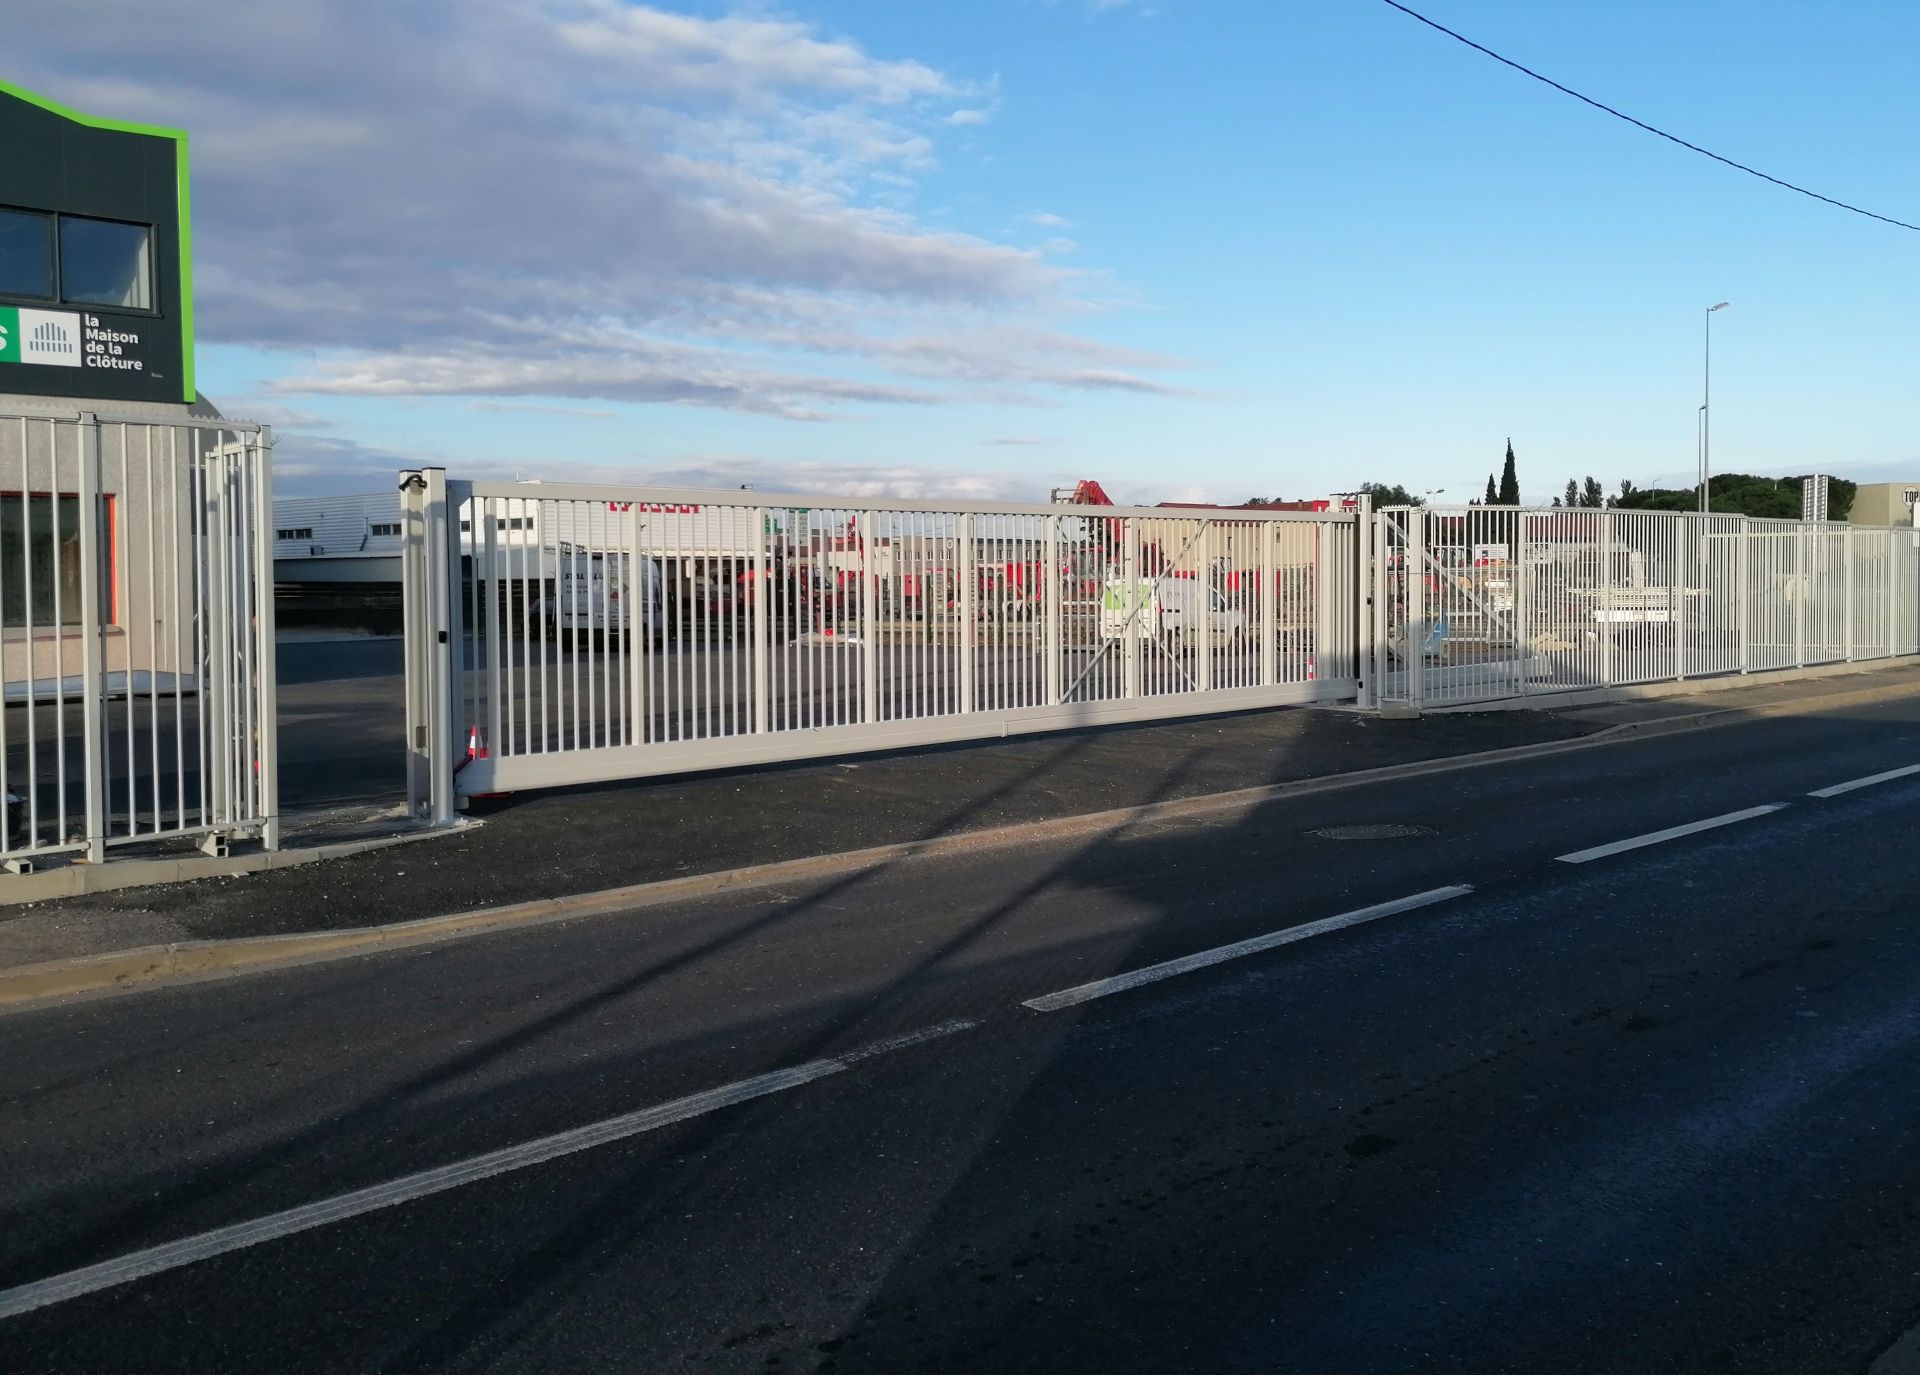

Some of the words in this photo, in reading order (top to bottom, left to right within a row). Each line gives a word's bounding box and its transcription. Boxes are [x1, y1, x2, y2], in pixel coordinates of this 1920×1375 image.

[85, 313, 99, 327] la
[85, 328, 139, 344] Maison
[85, 341, 105, 354] de
[109, 343, 123, 356] la
[86, 355, 143, 371] Clôture
[1904, 491, 1919, 502] TOP
